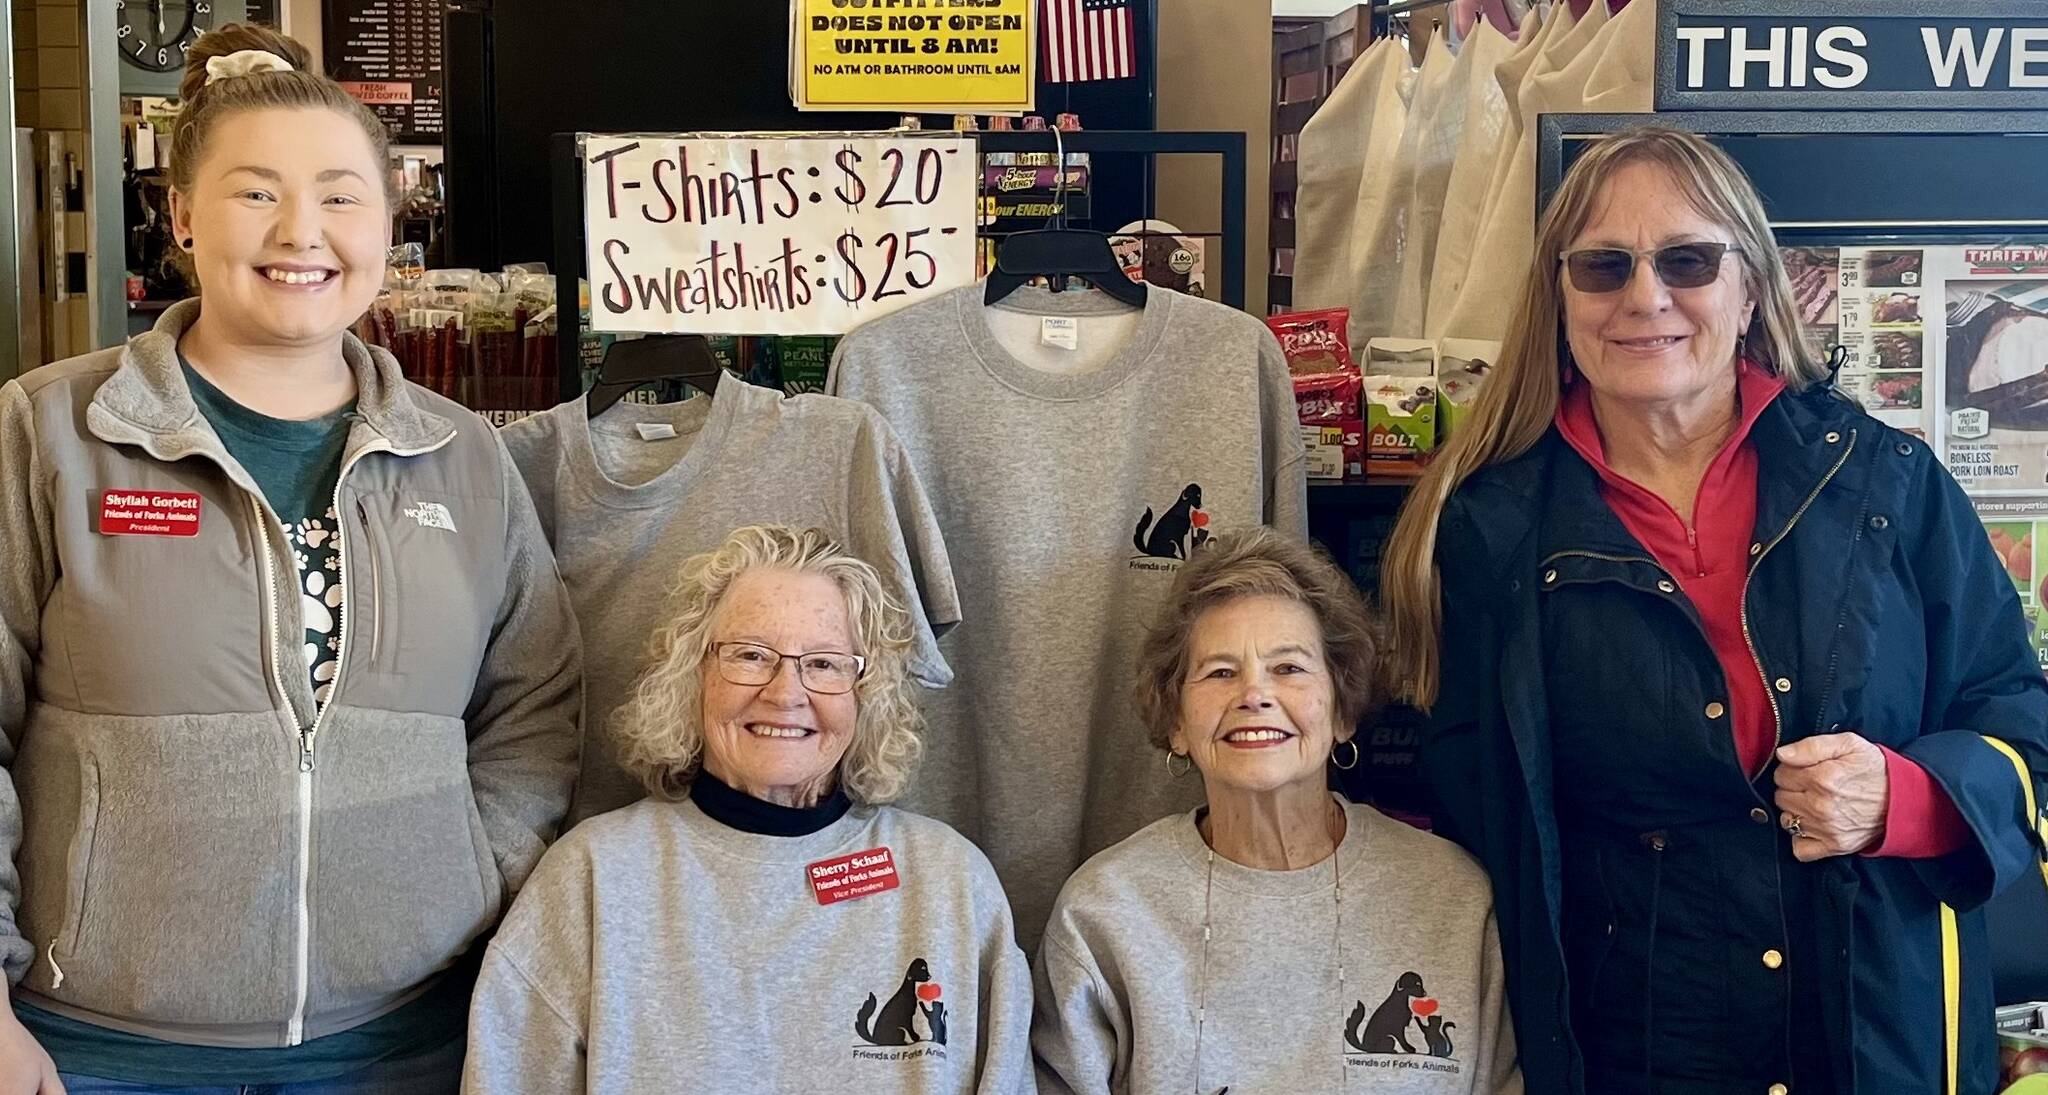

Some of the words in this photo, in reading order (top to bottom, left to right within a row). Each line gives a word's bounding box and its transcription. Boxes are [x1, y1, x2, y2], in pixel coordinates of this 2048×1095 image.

[811, 15, 883, 31] DOES
[888, 15, 943, 31] NOT
[948, 15, 1022, 31] OPEN
[136, 39, 147, 56] 7
[834, 38, 915, 53] UNTIL
[921, 38, 940, 53] 8
[945, 38, 999, 53] AM!
[158, 47, 168, 65] 6
[1676, 26, 1869, 89] THIS
[1920, 27, 2048, 88] WE
[814, 64, 832, 74] NO
[835, 64, 861, 74] ATM
[864, 64, 881, 74] OR
[884, 64, 954, 75] BATHROOM
[957, 64, 992, 74] UNTIL
[995, 64, 1021, 74] 8AM
[1371, 433, 1420, 447] BOLT
[1950, 452, 1991, 464] BONELESS
[1950, 465, 1971, 477] PORK
[1973, 465, 1992, 477] LOIN
[1993, 464, 2019, 476] ROAST
[151, 496, 198, 509] Gorbett
[1129, 560, 1159, 571] Friends
[812, 862, 850, 878] Sherry
[851, 850, 889, 869] Schaaf
[852, 1049, 889, 1060] Friends
[890, 1051, 900, 1060] of
[1380, 1059, 1391, 1068] of
[1393, 1060, 1419, 1070] Forks
[1421, 1061, 1460, 1074] Animals
